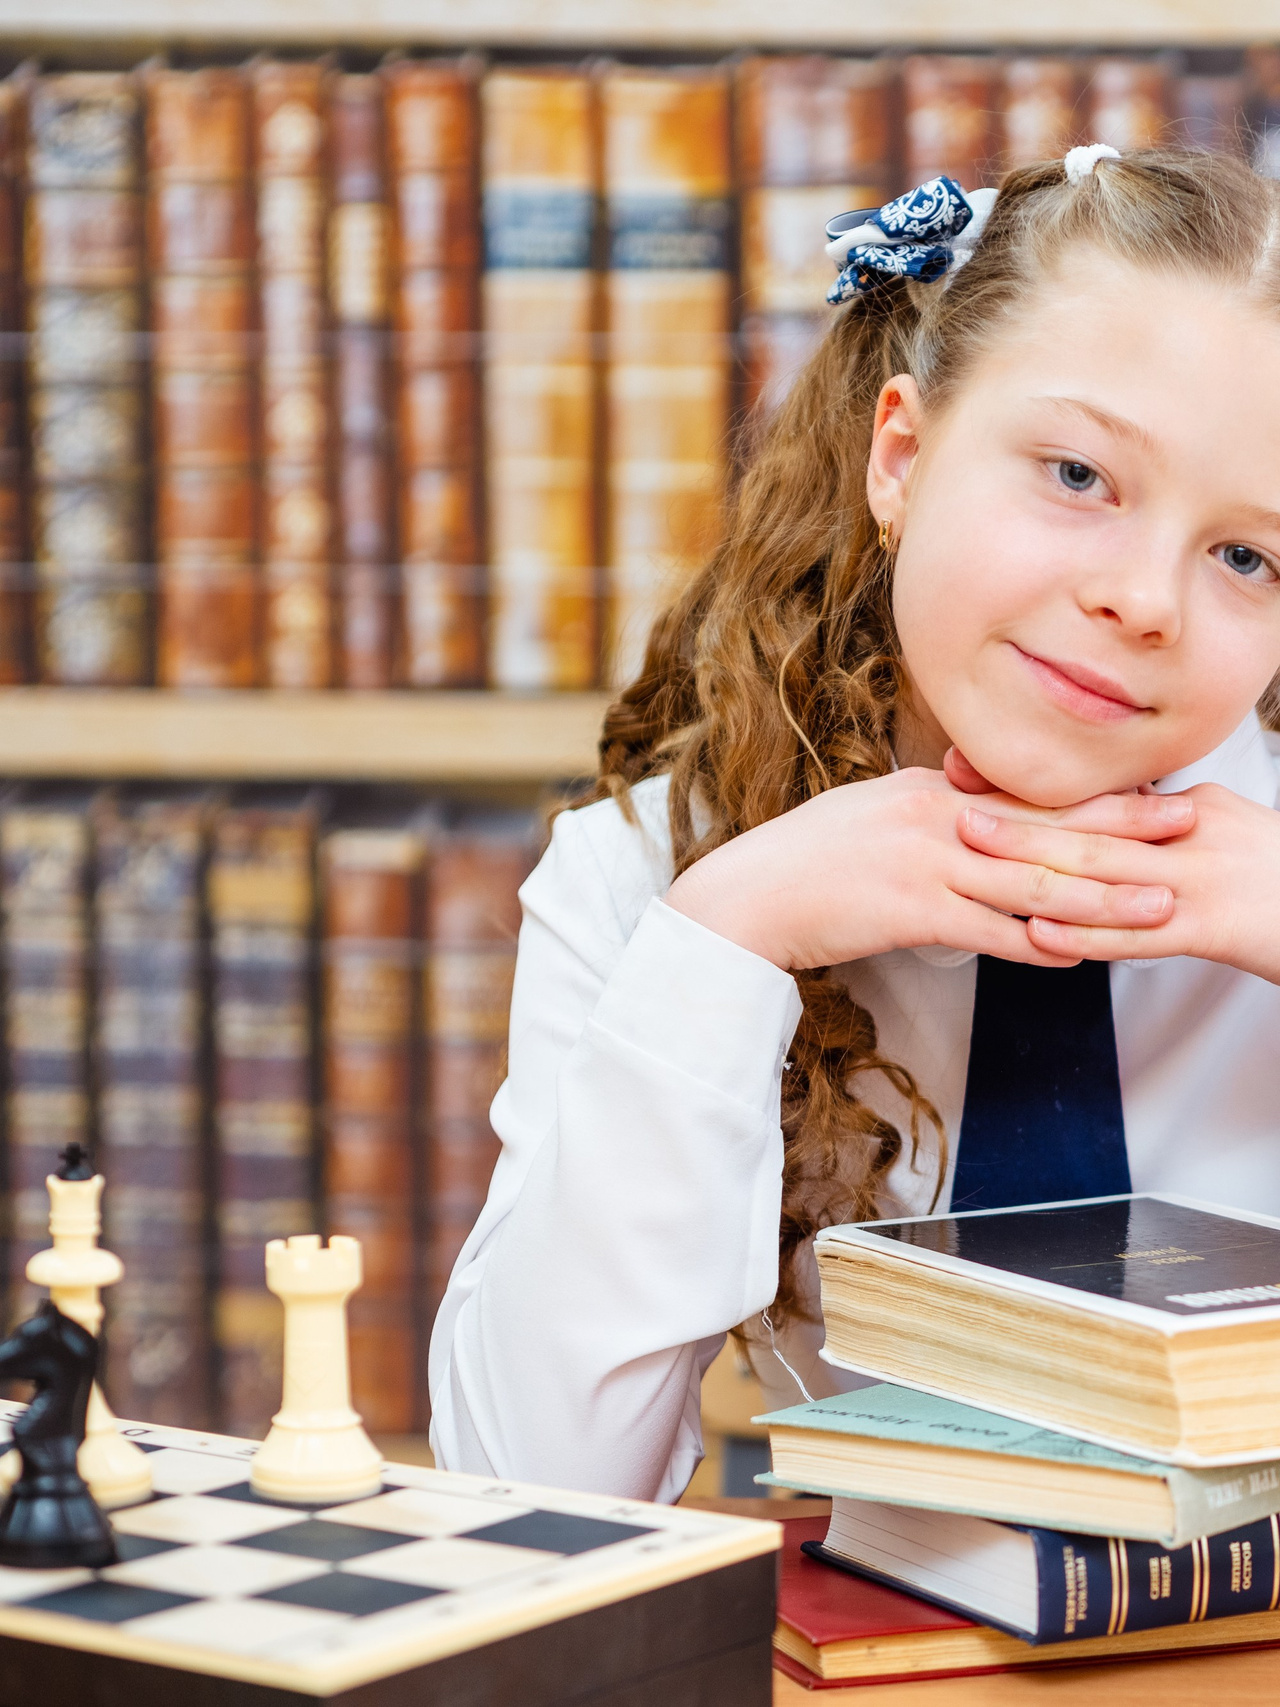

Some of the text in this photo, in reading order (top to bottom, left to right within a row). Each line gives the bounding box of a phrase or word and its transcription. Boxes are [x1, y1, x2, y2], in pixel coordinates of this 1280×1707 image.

[1250, 1466, 1279, 1495] ТРИ
[1063, 1545, 1076, 1634] ИЗБРАННЫЕ
[1076, 1556, 1088, 1621] РОМАНЫ
[1160, 1555, 1172, 1598] НИГДЕ
[1229, 1541, 1241, 1593] ЛЕТНИЙ
[1242, 1541, 1252, 1590] ОСТРОВ
